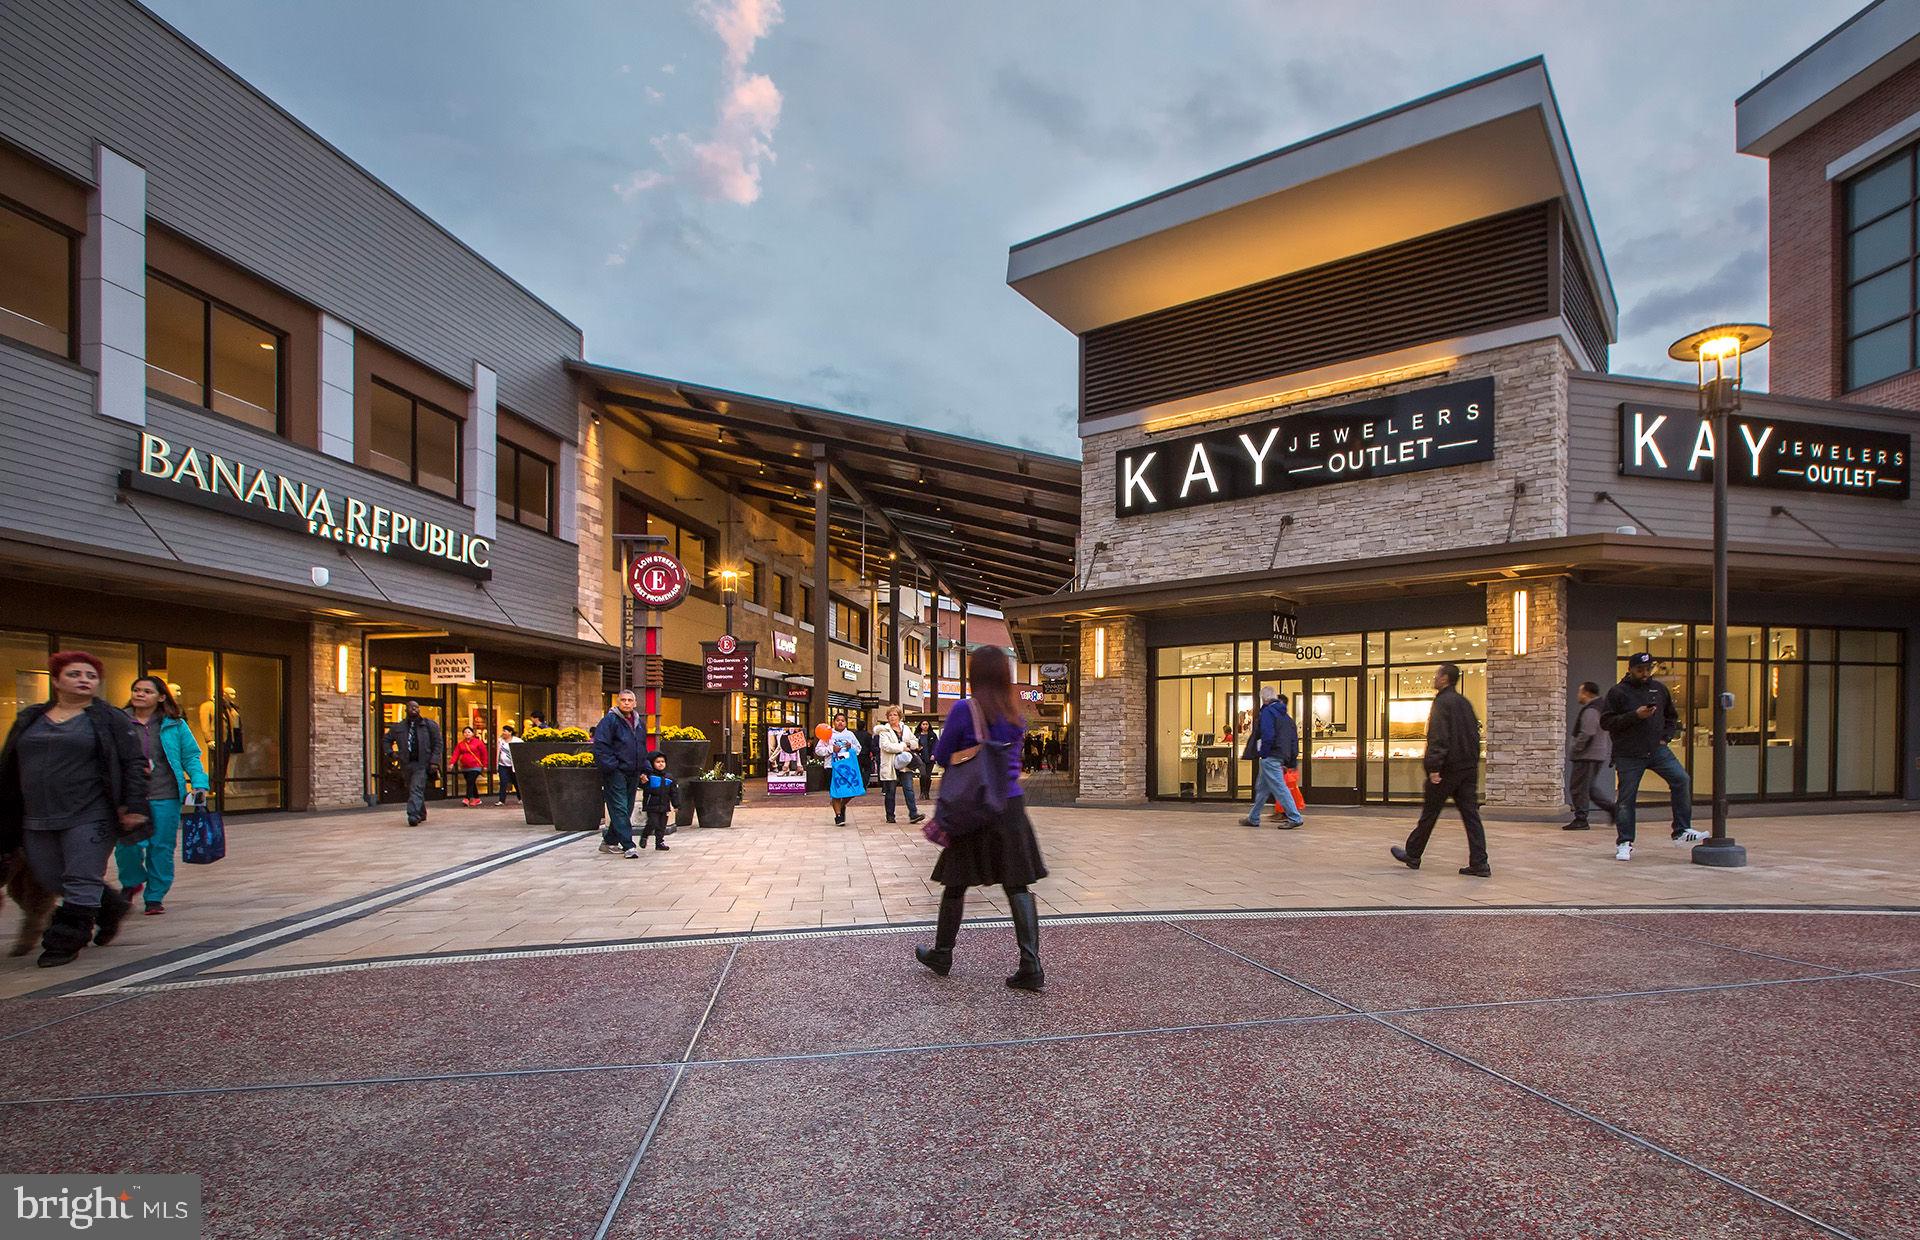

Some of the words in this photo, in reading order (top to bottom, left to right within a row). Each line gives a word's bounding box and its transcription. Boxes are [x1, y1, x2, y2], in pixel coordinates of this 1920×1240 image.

[1123, 427, 1280, 508] KAY
[1288, 403, 1480, 452] JEWELERS
[1327, 437, 1434, 474] OUTLET
[1633, 412, 1774, 478] KAY
[1778, 439, 1904, 466] JEWELERS
[1807, 464, 1877, 488] OUTLET
[139, 431, 336, 526] BANANA
[345, 496, 491, 568] REPUBLIC
[308, 519, 392, 553] FACTORY
[637, 556, 653, 570] LOW
[653, 555, 678, 570] STREET
[651, 570, 666, 591] E
[634, 582, 648, 598] EAST
[646, 583, 681, 603] PROMENADE
[1273, 614, 1297, 636] KAY
[1296, 645, 1323, 660] 800
[404, 679, 419, 691] 700
